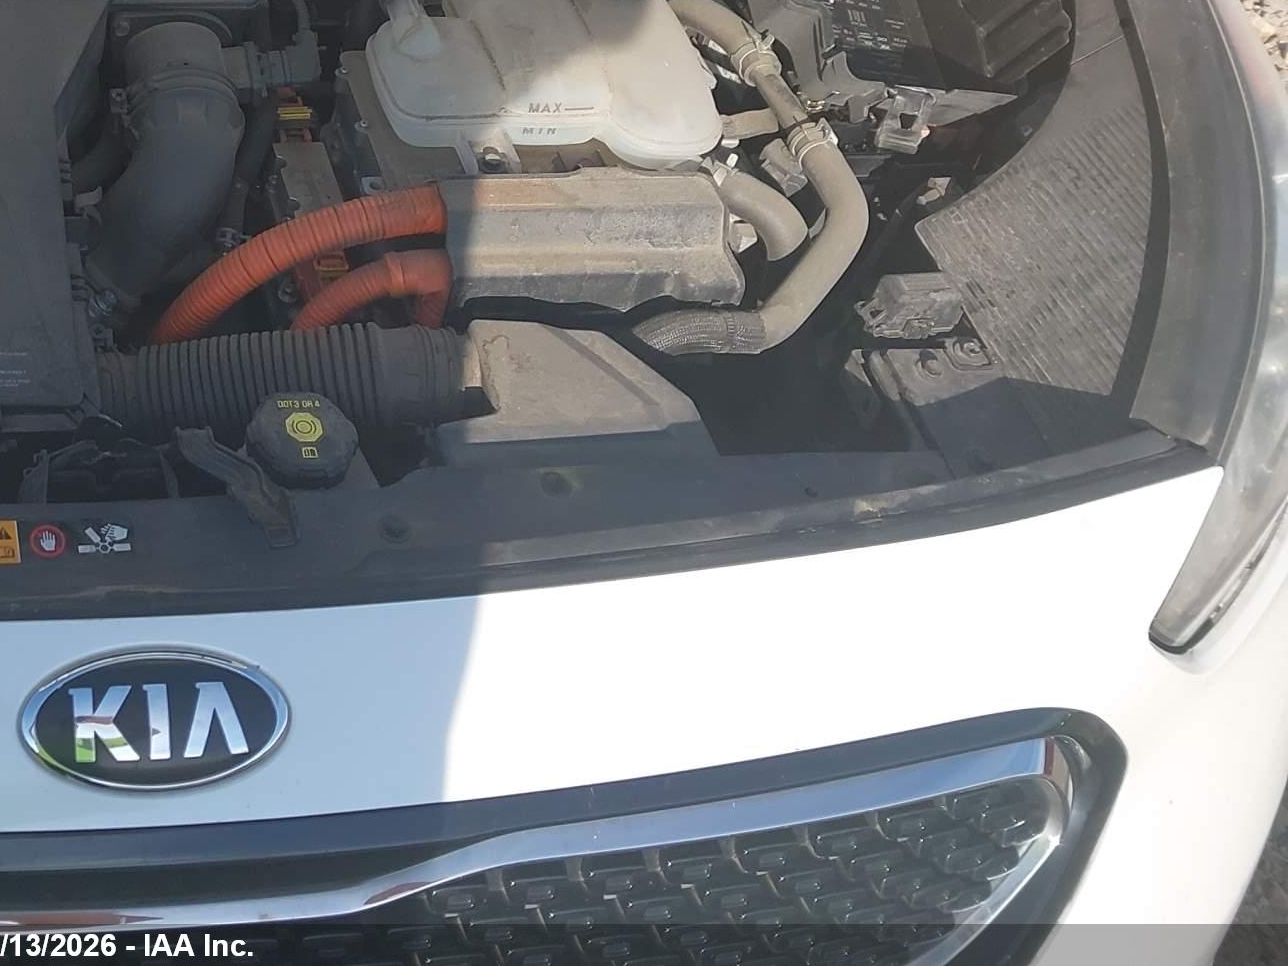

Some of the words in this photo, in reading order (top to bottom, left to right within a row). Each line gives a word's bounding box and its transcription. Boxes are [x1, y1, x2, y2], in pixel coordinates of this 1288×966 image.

[528, 102, 563, 114] MAX
[522, 127, 557, 135] MIN
[68, 681, 250, 763] KIA
